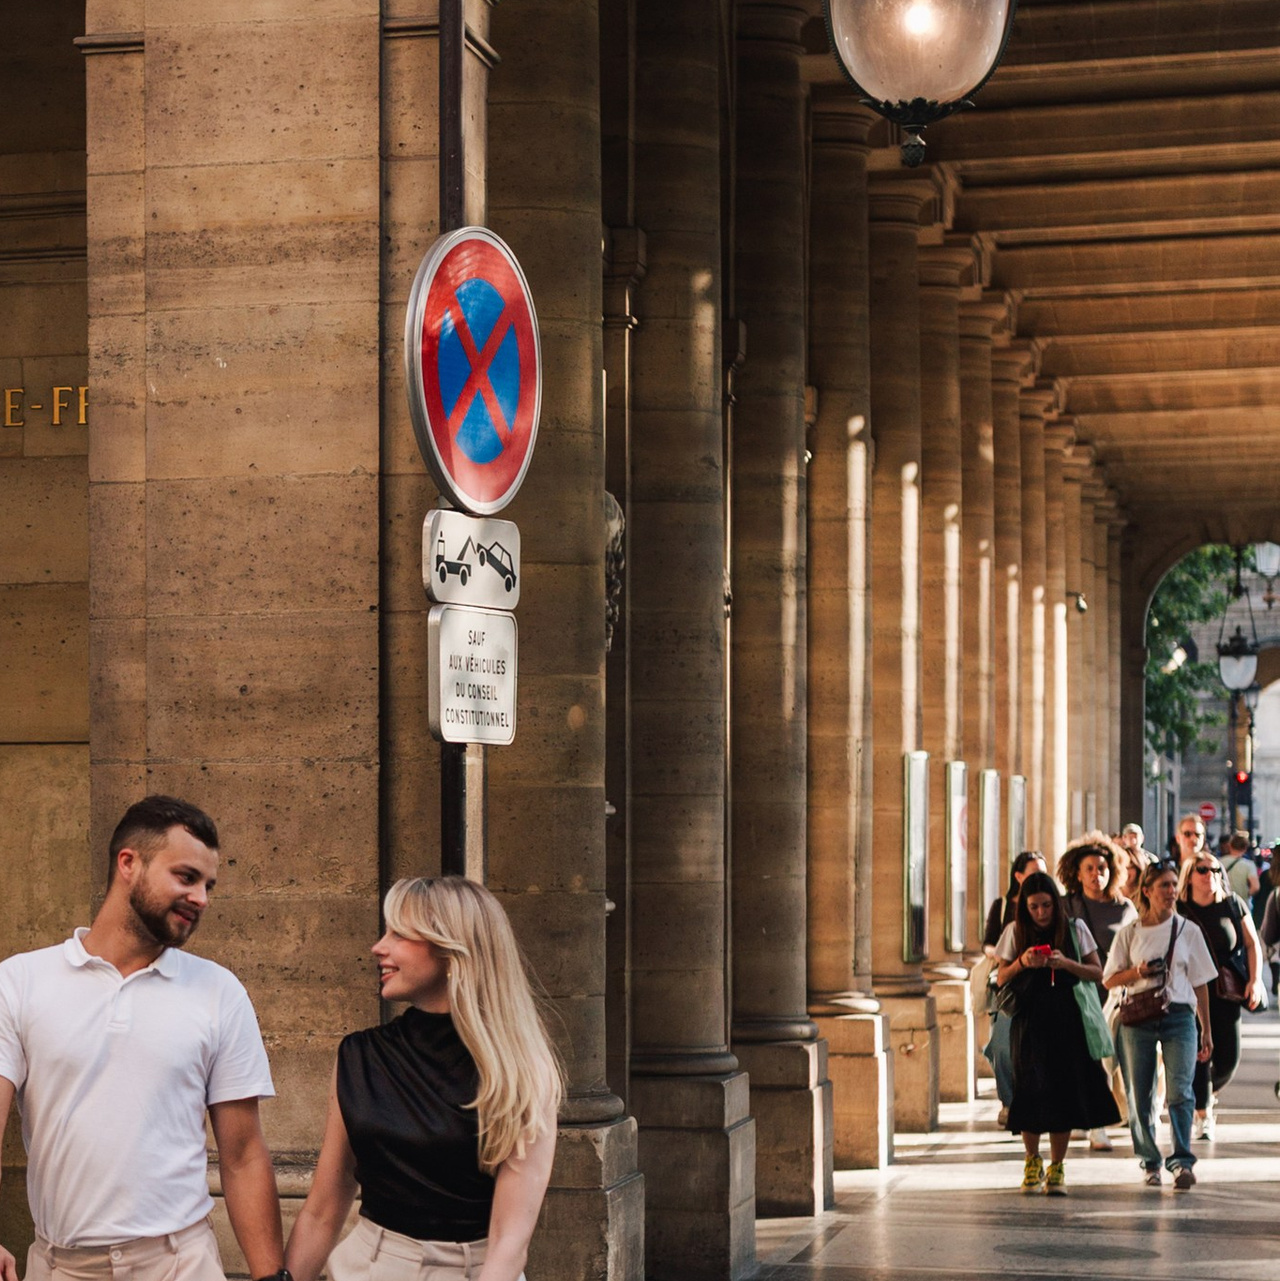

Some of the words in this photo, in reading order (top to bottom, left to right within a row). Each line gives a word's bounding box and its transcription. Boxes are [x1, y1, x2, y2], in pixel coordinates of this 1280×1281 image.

[468, 630, 486, 647] SAUF
[449, 654, 462, 672] AUX
[465, 653, 506, 675] VÉHICULES
[456, 682, 465, 698] DU
[468, 683, 498, 701] CONSEIL
[446, 707, 509, 728] CONSTITUTIONNEL
